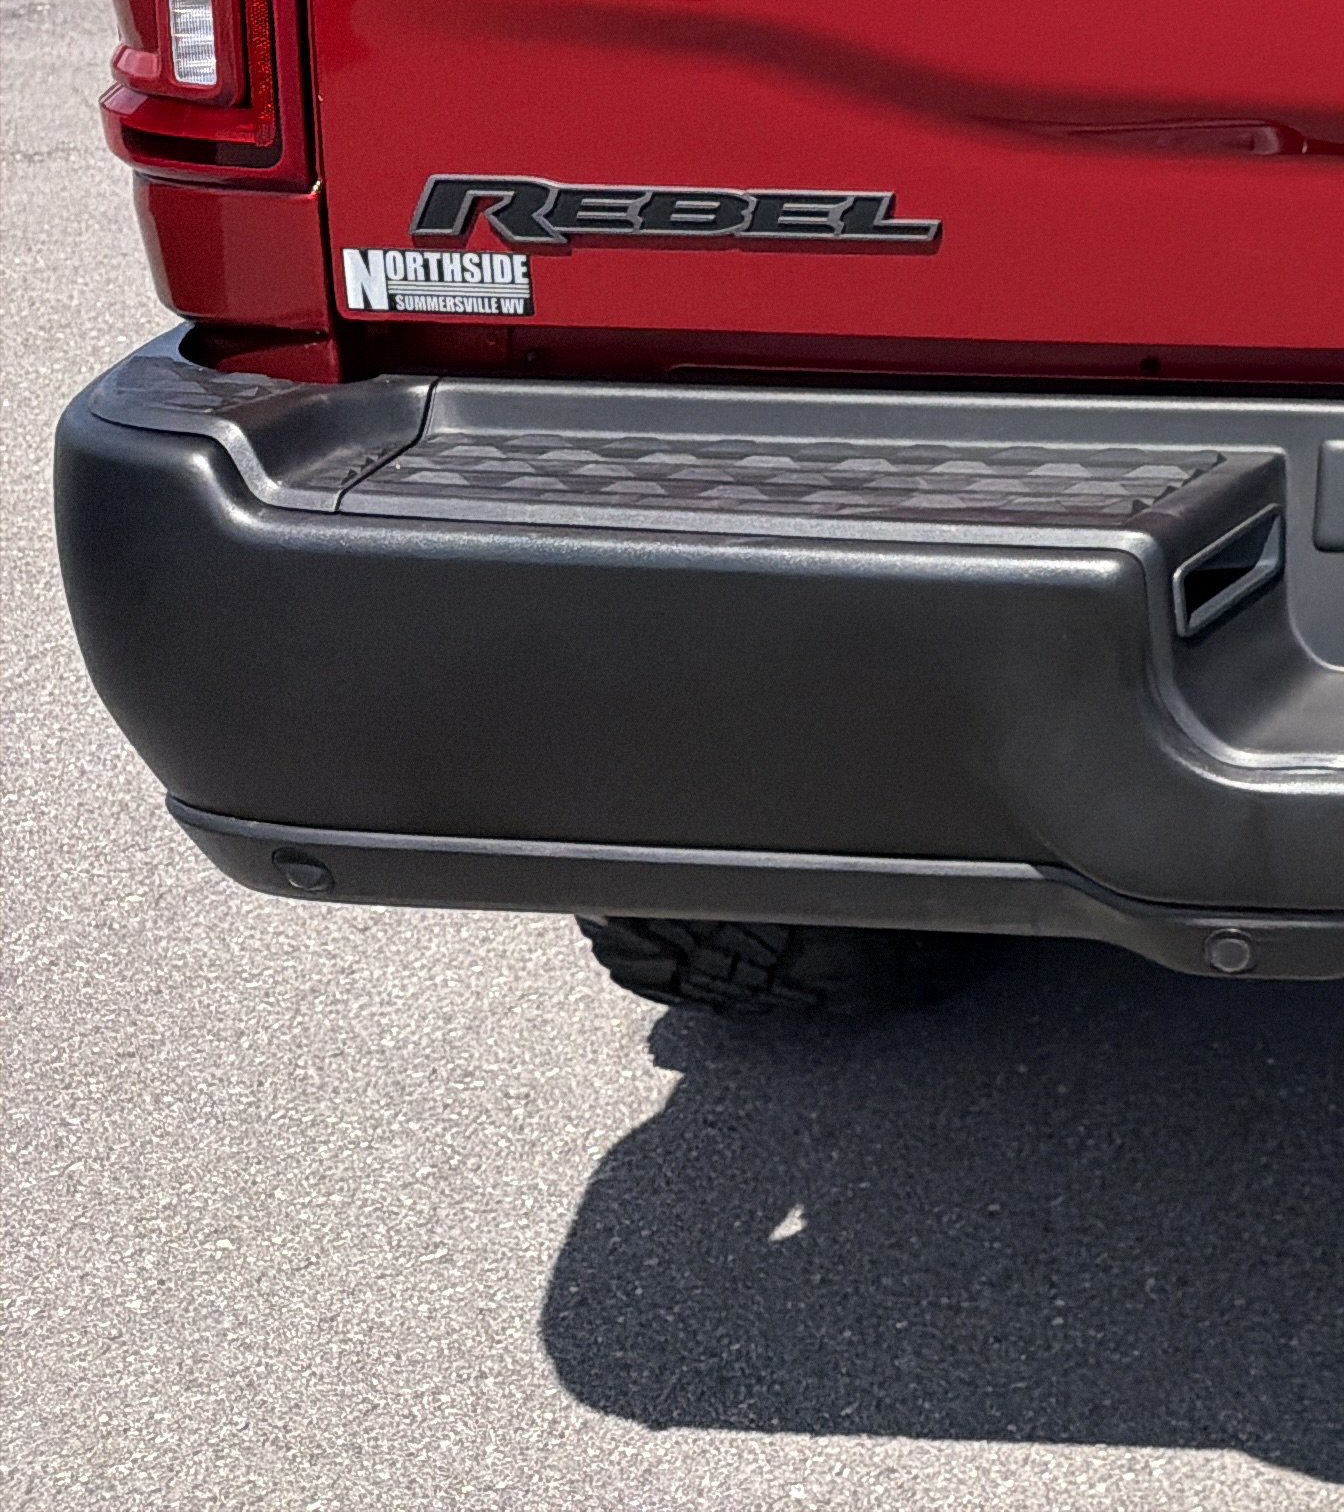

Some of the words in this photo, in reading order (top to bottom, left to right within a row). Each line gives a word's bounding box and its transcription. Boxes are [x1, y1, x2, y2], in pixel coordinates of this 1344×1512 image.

[409, 174, 943, 244] REBEL
[342, 248, 529, 311] NORTHSIDE
[395, 294, 499, 314] SUMMERSVILLE
[500, 297, 525, 315] WV
